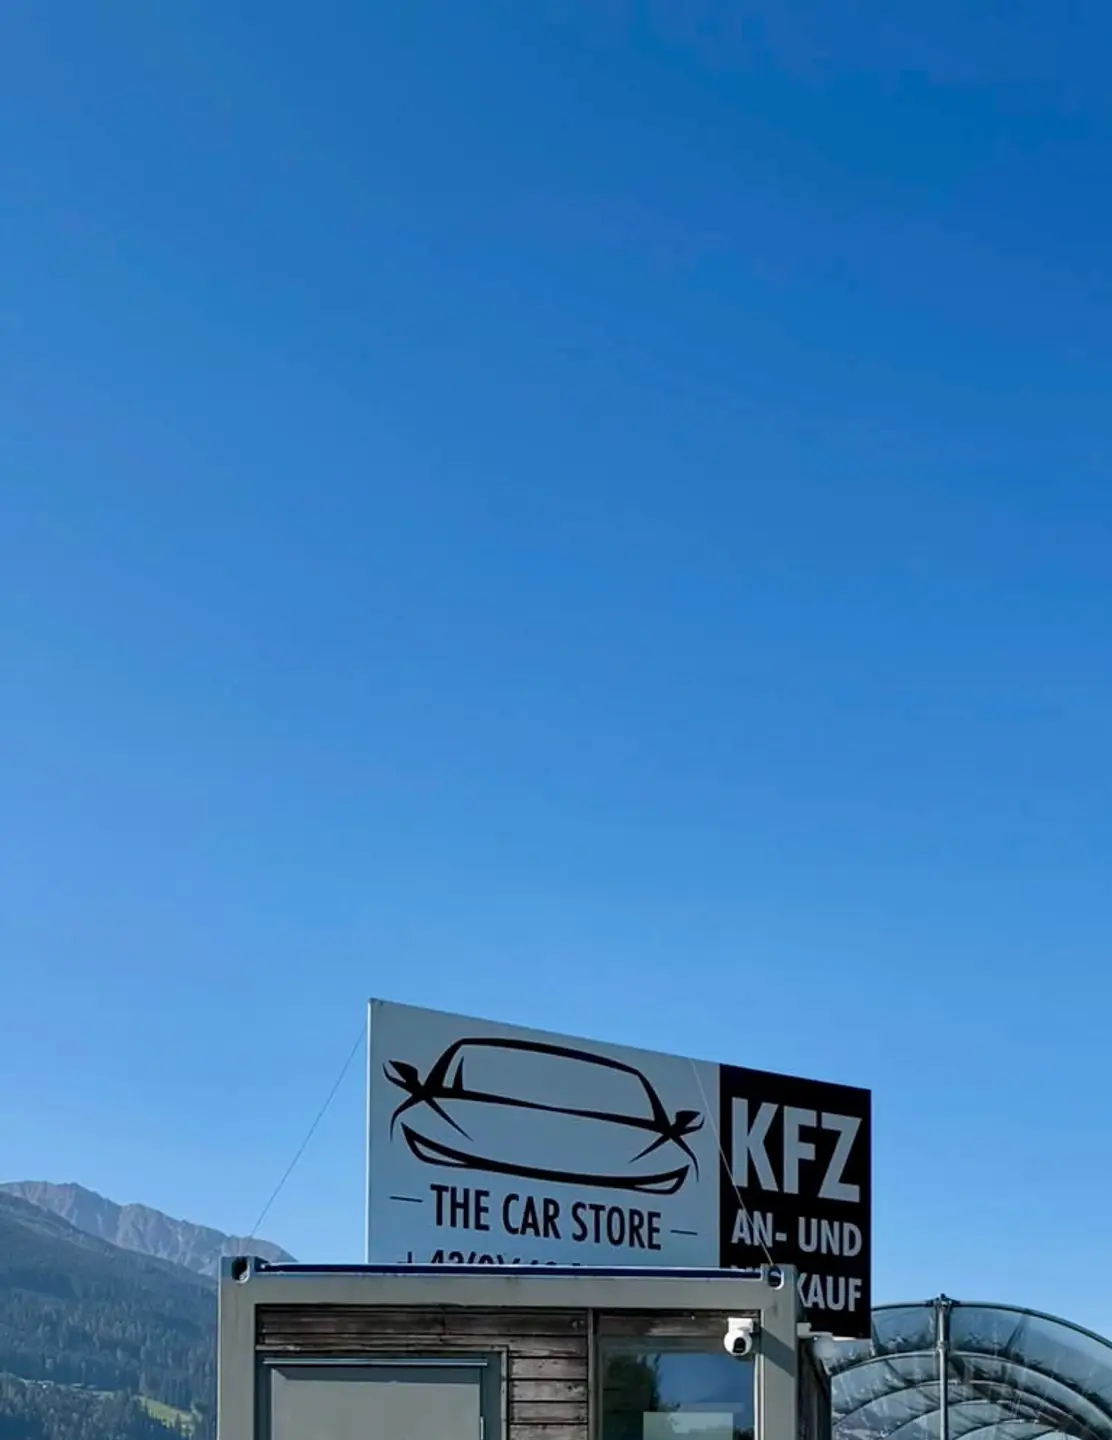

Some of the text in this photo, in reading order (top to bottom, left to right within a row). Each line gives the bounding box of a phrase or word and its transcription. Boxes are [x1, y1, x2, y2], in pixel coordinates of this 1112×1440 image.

[731, 1096, 863, 1203] KFZ
[430, 1184, 661, 1250] THE CAR STORE
[730, 1208, 863, 1257] AN- UND
